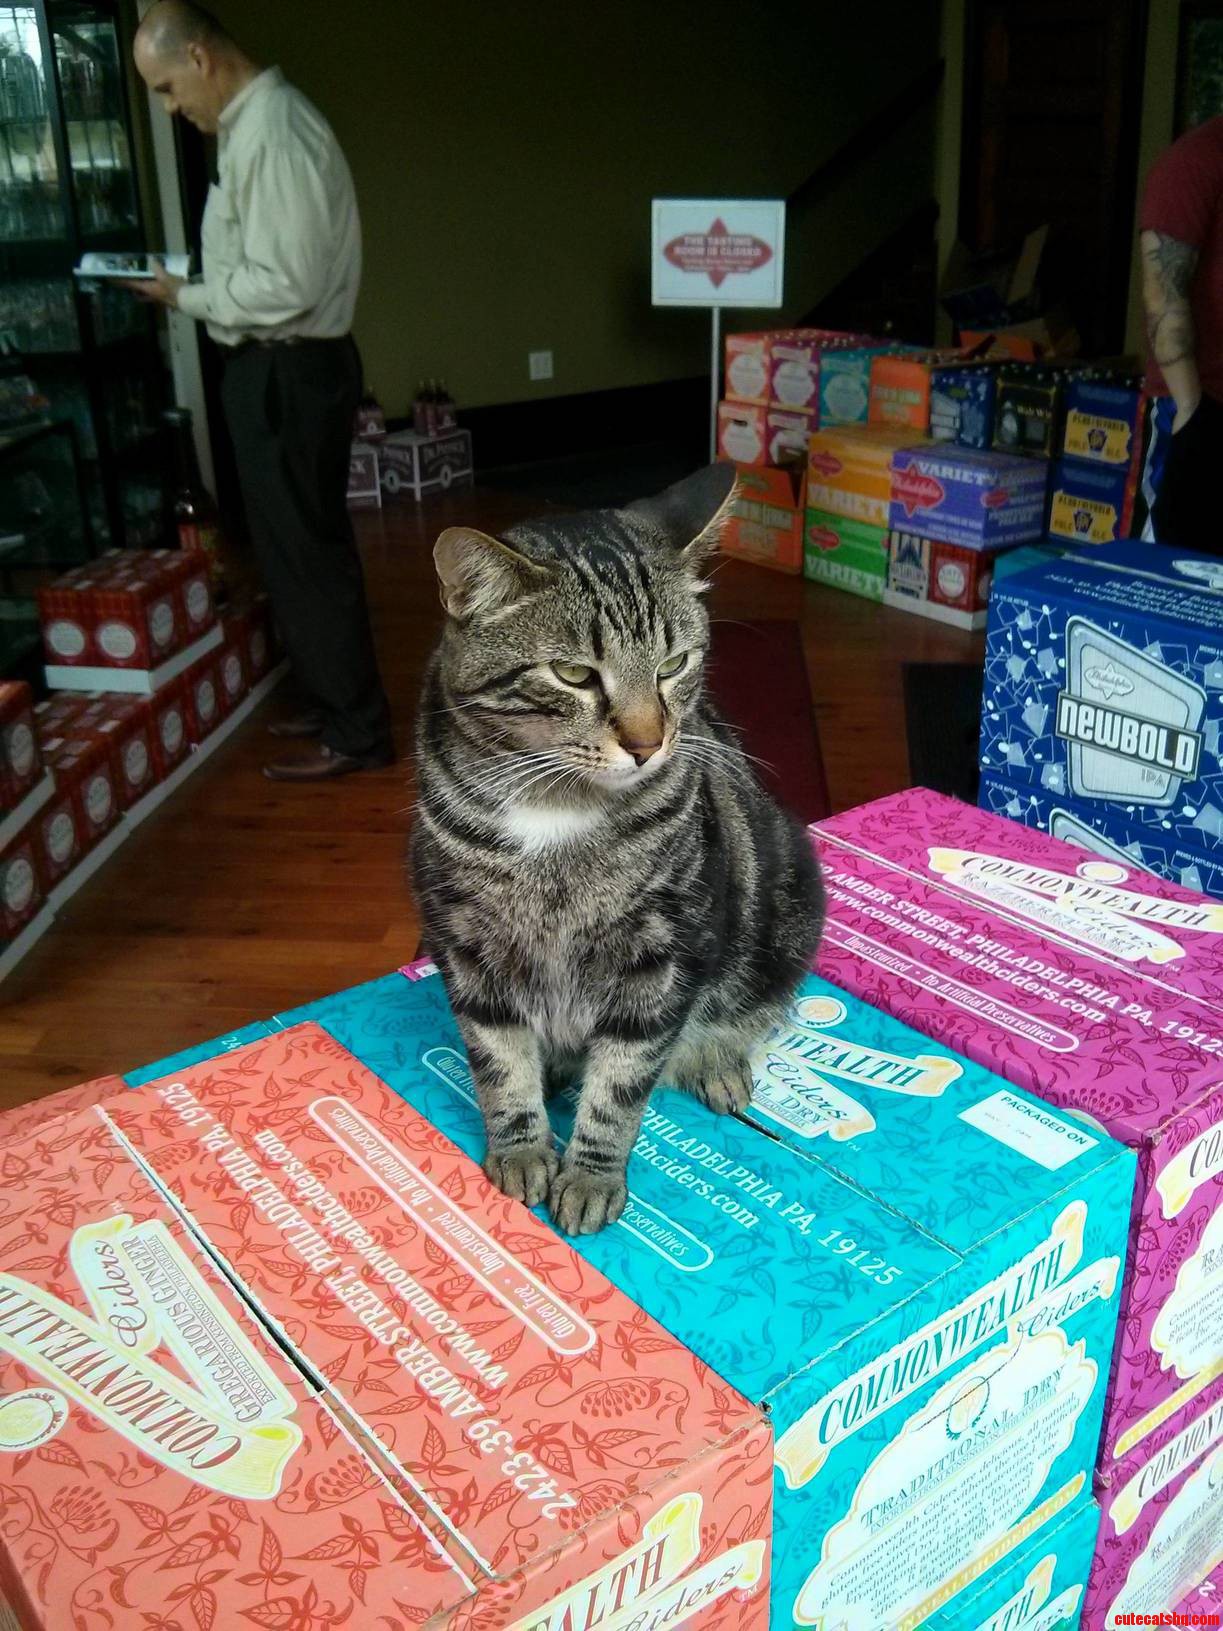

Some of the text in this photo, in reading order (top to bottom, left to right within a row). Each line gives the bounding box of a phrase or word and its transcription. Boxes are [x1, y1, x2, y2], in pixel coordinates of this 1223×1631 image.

[806, 556, 886, 594] VARIETY
[1141, 767, 1166, 788] IPA
[961, 856, 1211, 927] COMMONWEALTH
[828, 871, 897, 907] AMBER
[891, 900, 968, 941] STREET,
[964, 933, 1122, 1009] PHILADELPHIA
[1118, 1001, 1154, 1027] PA,
[1159, 1019, 1223, 1059] 1912
[980, 997, 1058, 1044] Preservatives
[765, 1052, 850, 1122] Ciders
[780, 1095, 828, 1125] DRY
[328, 1106, 386, 1161] Preservatives
[1001, 1096, 1066, 1134] PACKAGED
[1067, 1131, 1088, 1145] ON
[409, 1187, 433, 1207] No
[253, 1128, 510, 1390] www.commonwealthciders.com
[431, 1211, 505, 1275] Unpasteurized
[778, 1200, 817, 1236] PA,
[817, 1229, 904, 1286] 19125
[94, 1239, 148, 1348] Ciders
[156, 1082, 578, 1521] 2423-39 AMBER STREET, PHILADELPHIA PA, 19125
[183, 1284, 226, 1339] KENSINGTON
[514, 1282, 538, 1310] Free
[536, 1298, 576, 1338] Gluten
[1017, 1279, 1103, 1337] Ciders
[121, 1235, 264, 1423] GREGARIOUS GINGER
[221, 1336, 242, 1362] FROM
[819, 1240, 1066, 1445] COMMONWEALTH
[0, 1285, 241, 1469] COMMONWEALT
[236, 1358, 275, 1405] EXPORTED
[860, 1364, 1065, 1529] TRADITIONAL DRY
[821, 1569, 858, 1610] gluten
[861, 1549, 883, 1577] free
[886, 1523, 918, 1557] ciders
[952, 1467, 991, 1506] without
[830, 1511, 919, 1588] Commonwealth
[923, 1482, 957, 1517] Ciders
